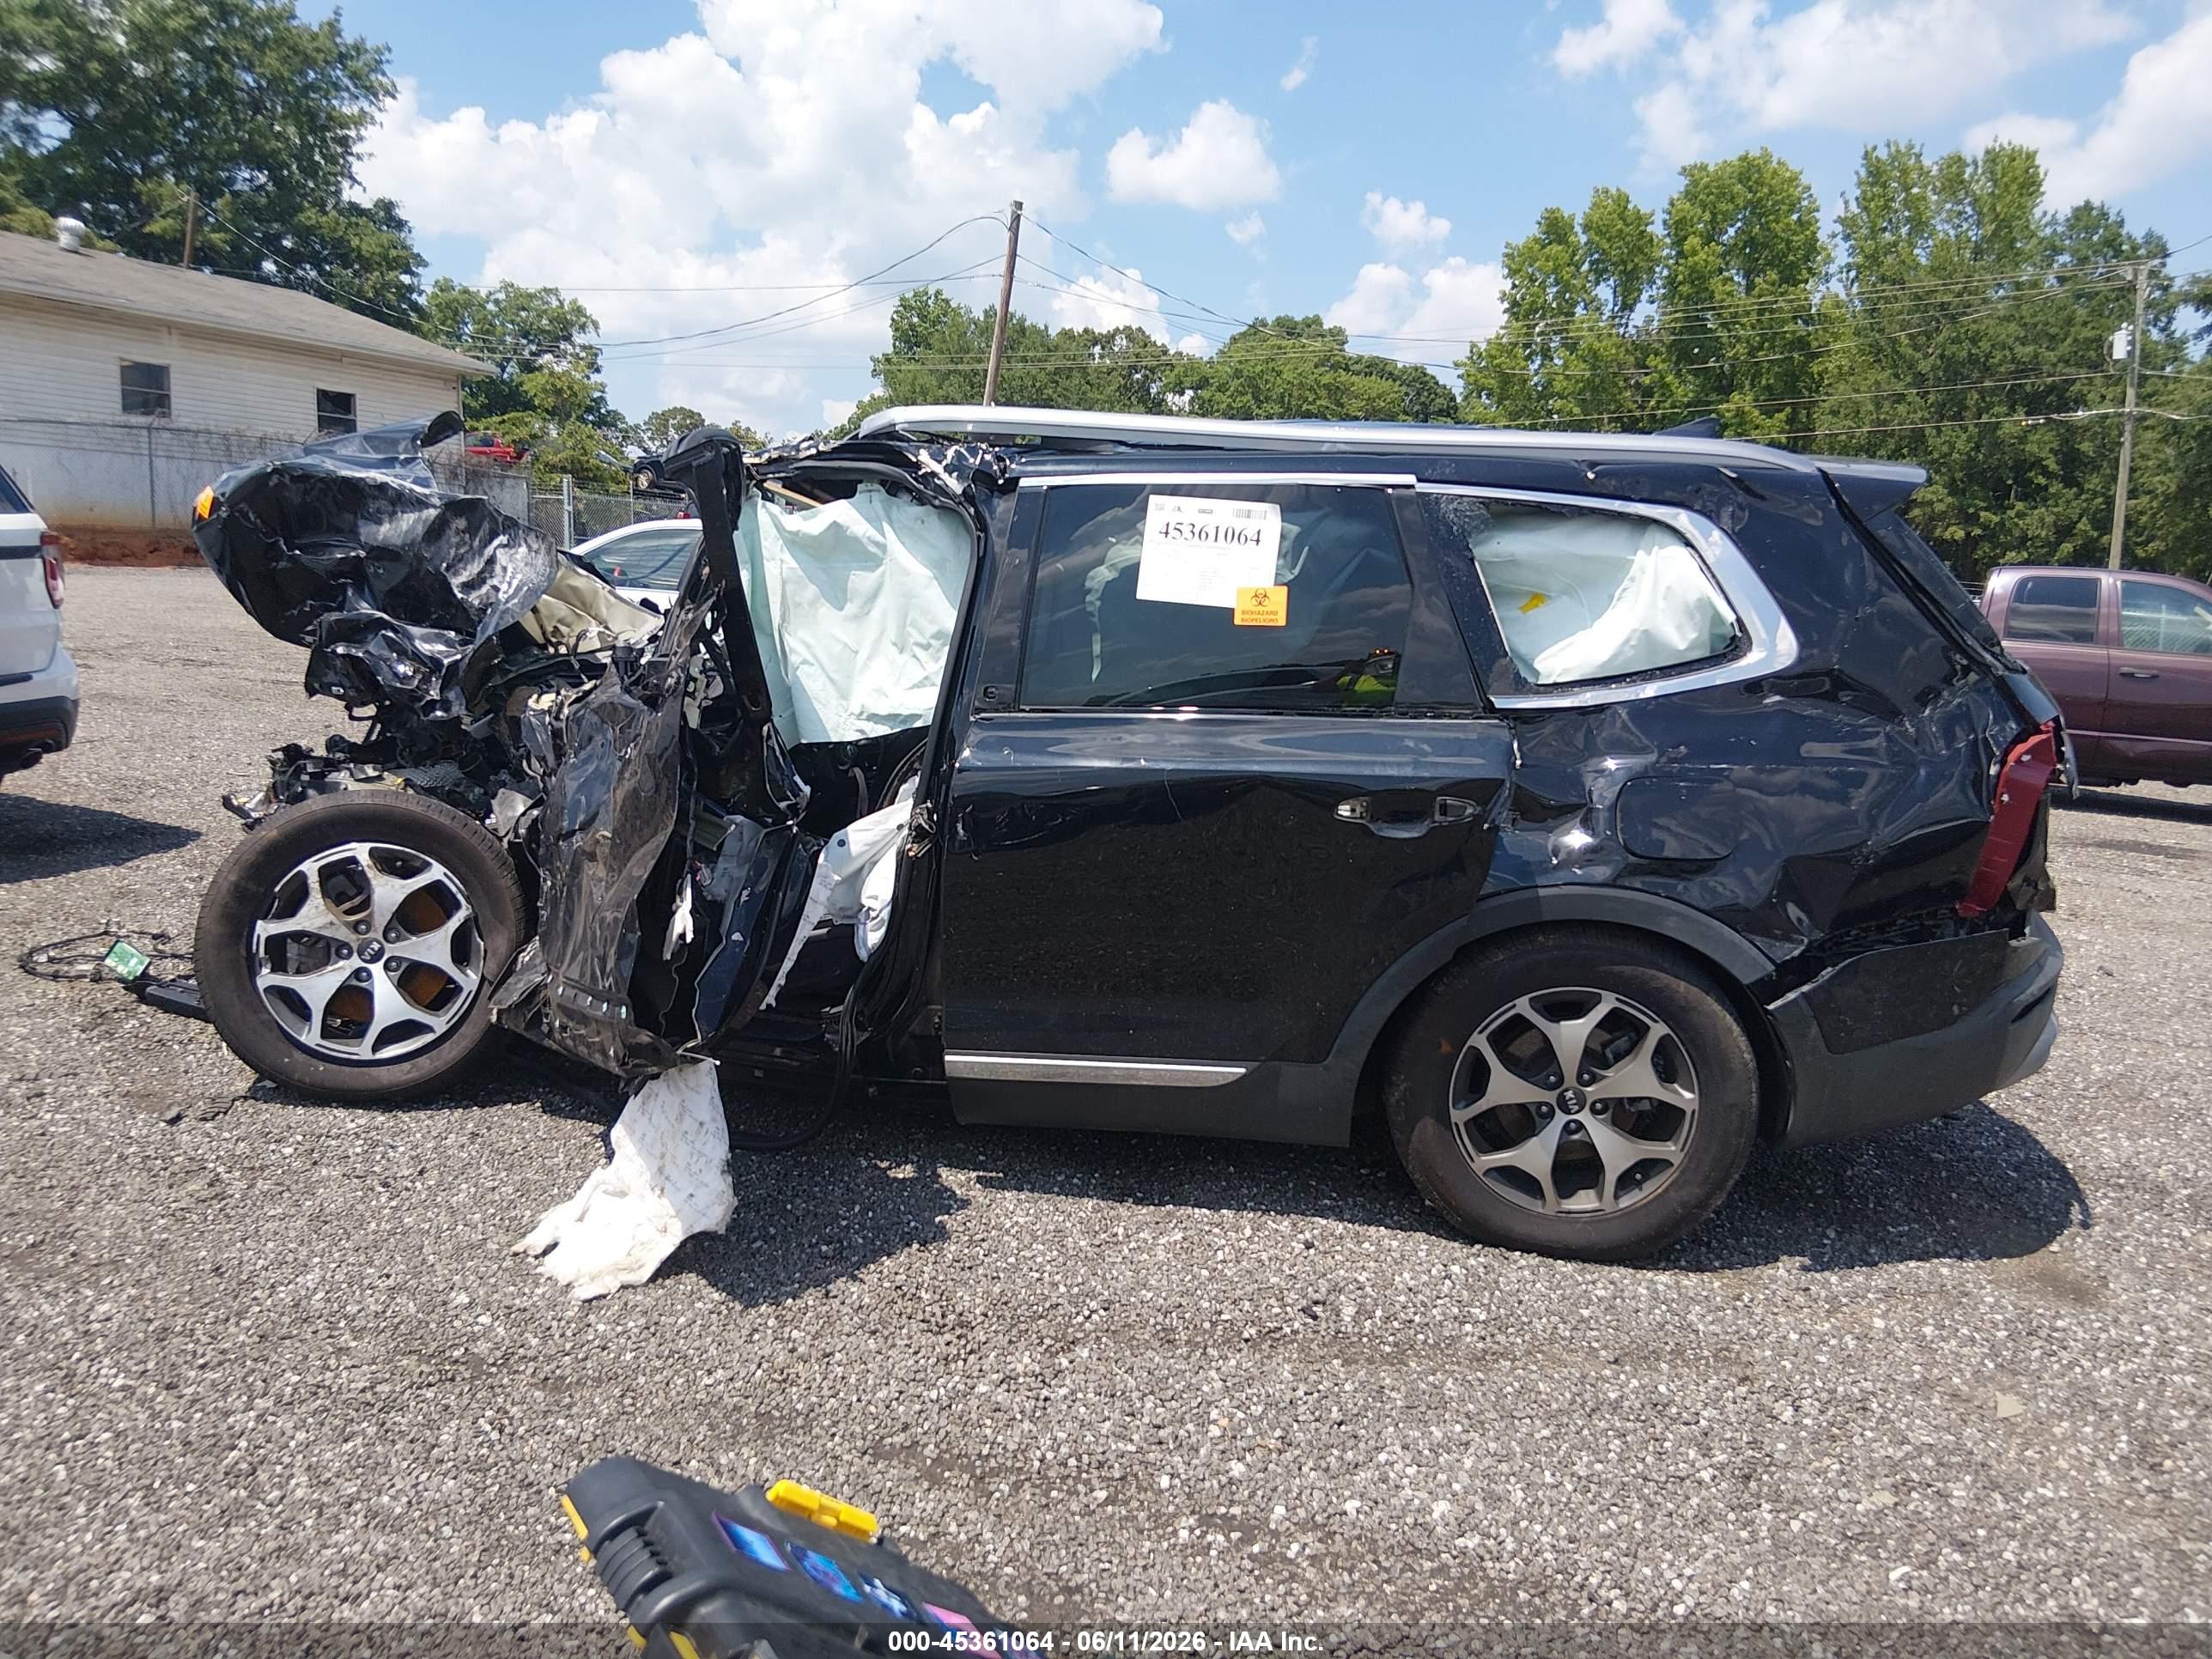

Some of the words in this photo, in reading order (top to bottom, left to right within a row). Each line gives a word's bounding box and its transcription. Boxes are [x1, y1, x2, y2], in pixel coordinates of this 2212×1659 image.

[1158, 521, 1261, 546] 45361064
[361, 941, 381, 960] KIA
[1563, 1090, 1579, 1113] KIA
